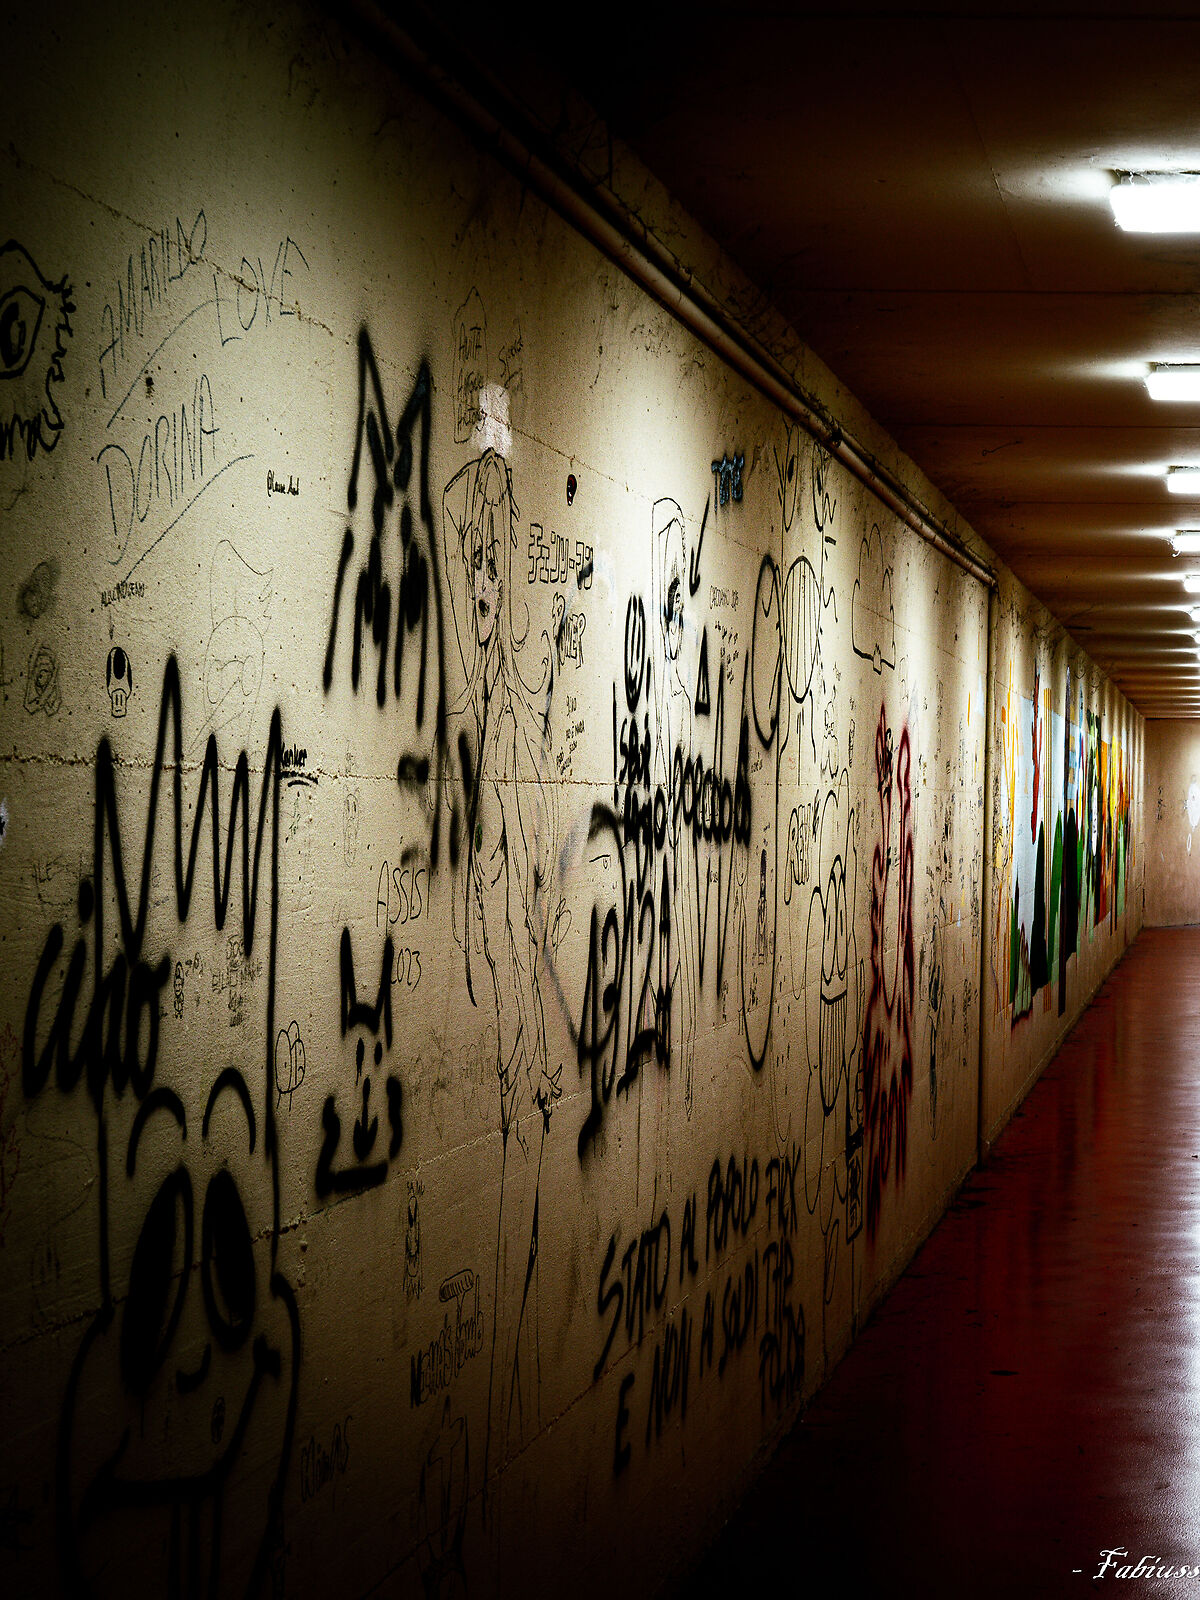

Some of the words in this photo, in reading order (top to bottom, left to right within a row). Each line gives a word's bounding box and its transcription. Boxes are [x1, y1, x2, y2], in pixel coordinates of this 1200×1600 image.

[212, 236, 310, 347] LOVE
[594, 1208, 670, 1383] STATO
[680, 1192, 699, 1285] AL
[706, 1155, 758, 1262] POPOLO
[613, 1372, 635, 1476] E
[645, 1308, 692, 1448] NON
